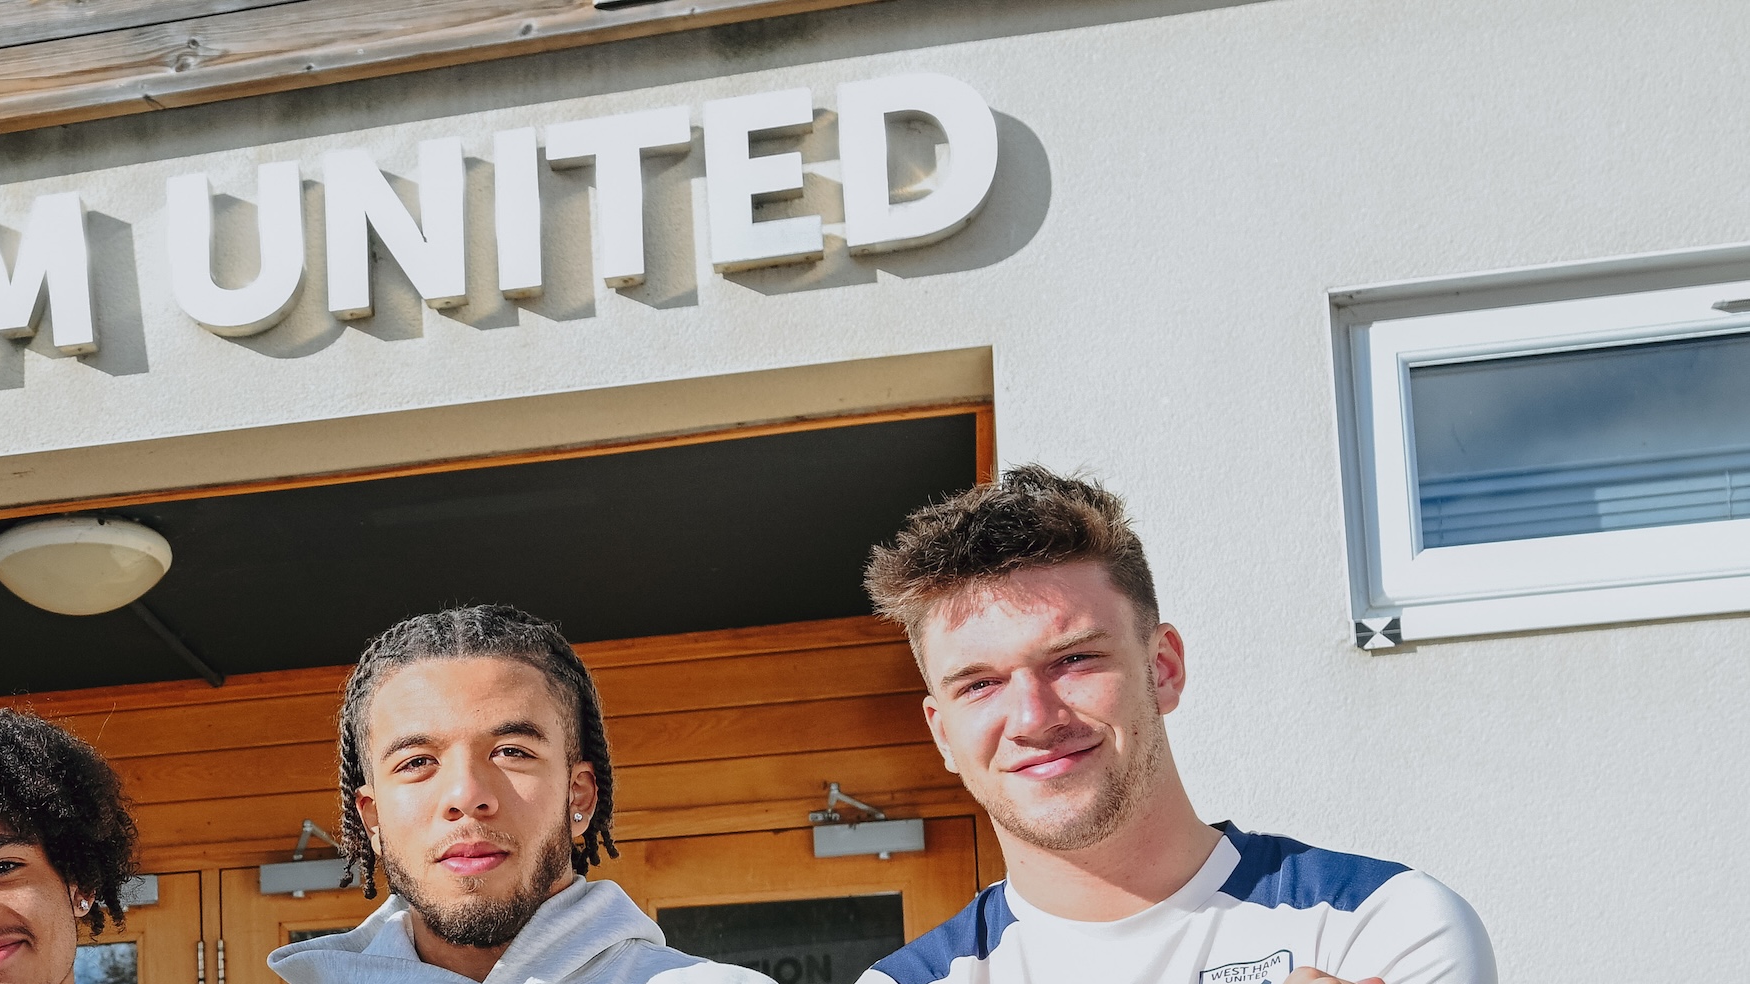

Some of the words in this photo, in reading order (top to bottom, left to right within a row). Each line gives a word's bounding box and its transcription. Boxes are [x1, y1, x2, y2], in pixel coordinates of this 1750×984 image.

[166, 72, 998, 337] UNITED
[1211, 966, 1249, 981] WEST
[1252, 955, 1281, 973] HAM
[1225, 970, 1268, 983] UNITED
